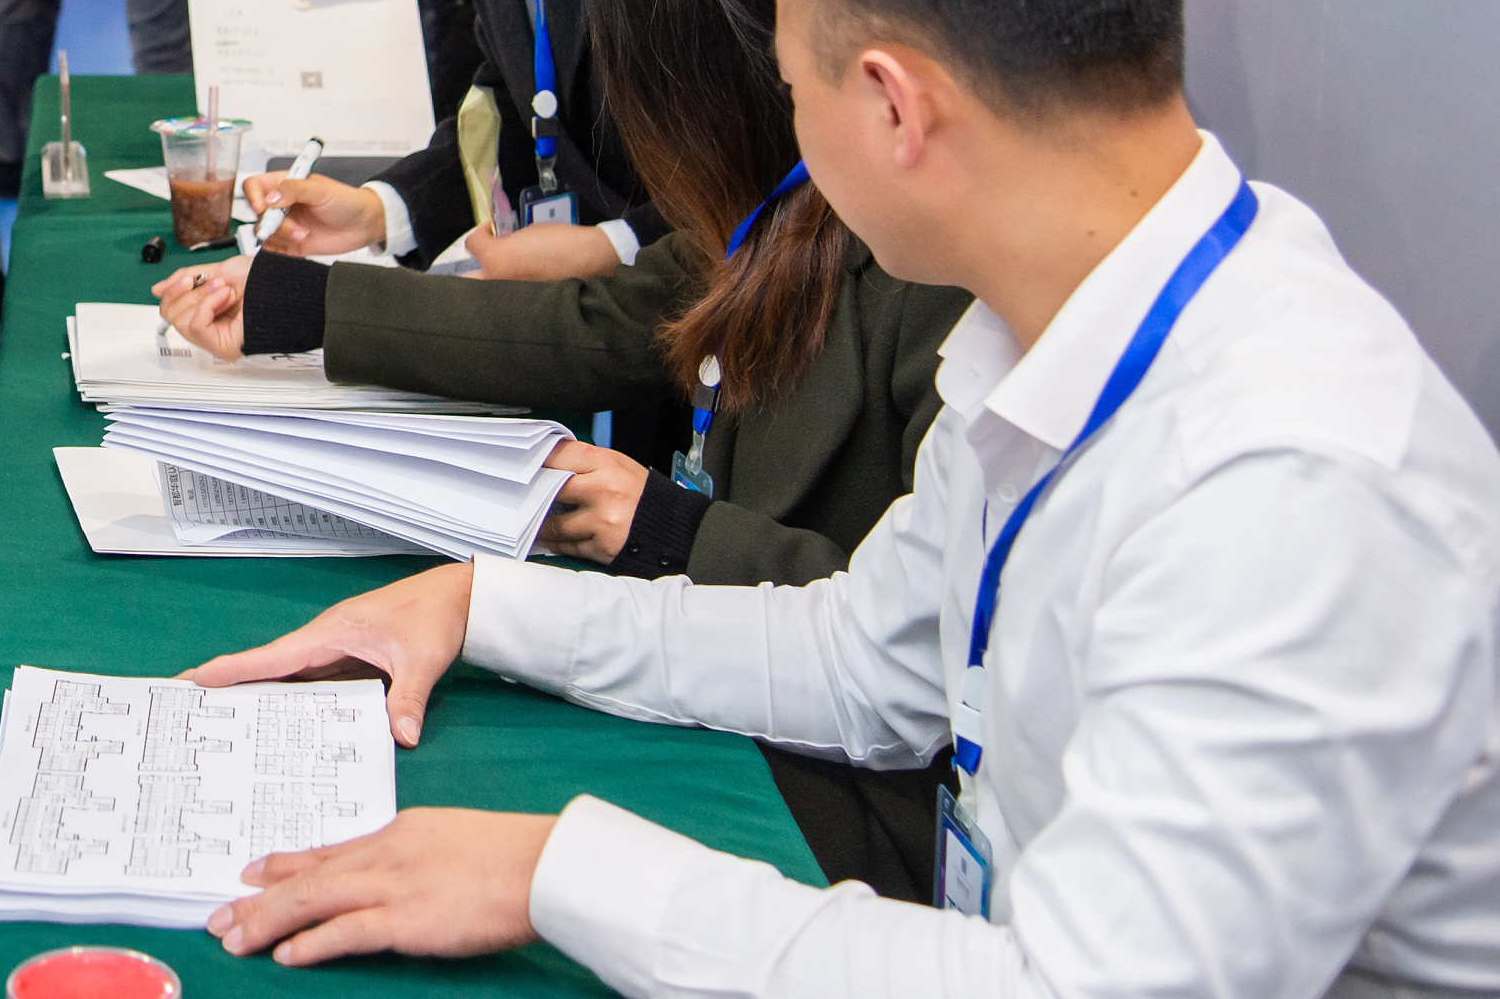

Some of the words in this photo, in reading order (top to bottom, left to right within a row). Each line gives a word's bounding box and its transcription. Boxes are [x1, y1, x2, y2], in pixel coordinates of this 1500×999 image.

[167, 462, 182, 506] 智都华庭认
